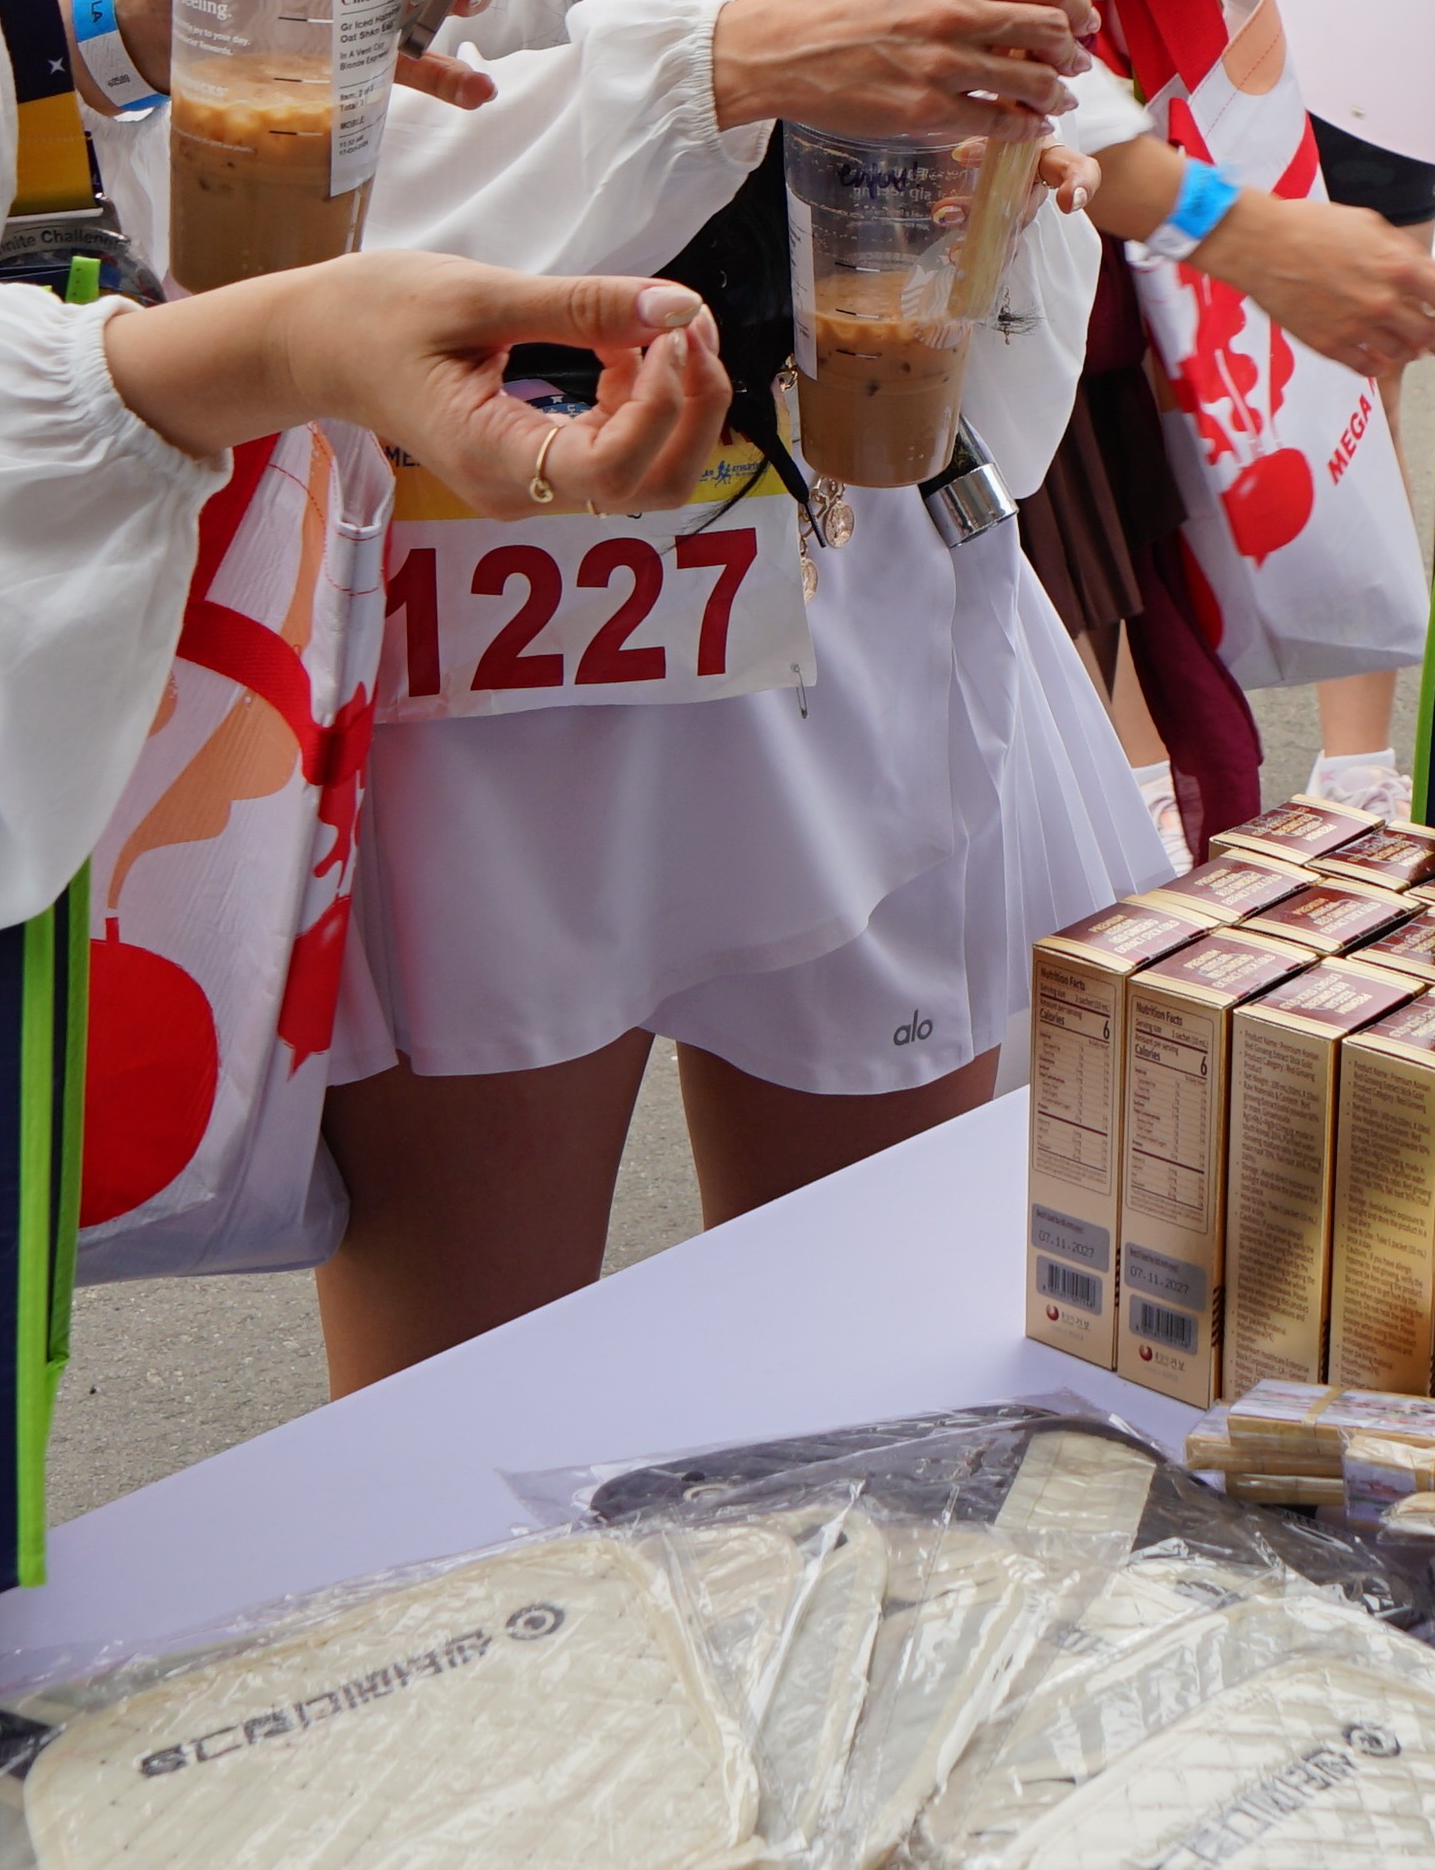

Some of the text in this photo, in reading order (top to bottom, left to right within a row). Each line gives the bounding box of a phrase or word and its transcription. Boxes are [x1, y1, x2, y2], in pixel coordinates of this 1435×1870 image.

[91, 1, 103, 23] LA
[41, 228, 128, 251] Challeng
[1326, 394, 1372, 486] MEGA
[385, 528, 757, 697] 1227
[1040, 966, 1086, 992] Nutrition Facts
[893, 1009, 933, 1046] alo
[1039, 1008, 1110, 1040] Calories 6
[1136, 1001, 1183, 1027] Nutrition Facts
[1134, 1043, 1208, 1077] Calories 6
